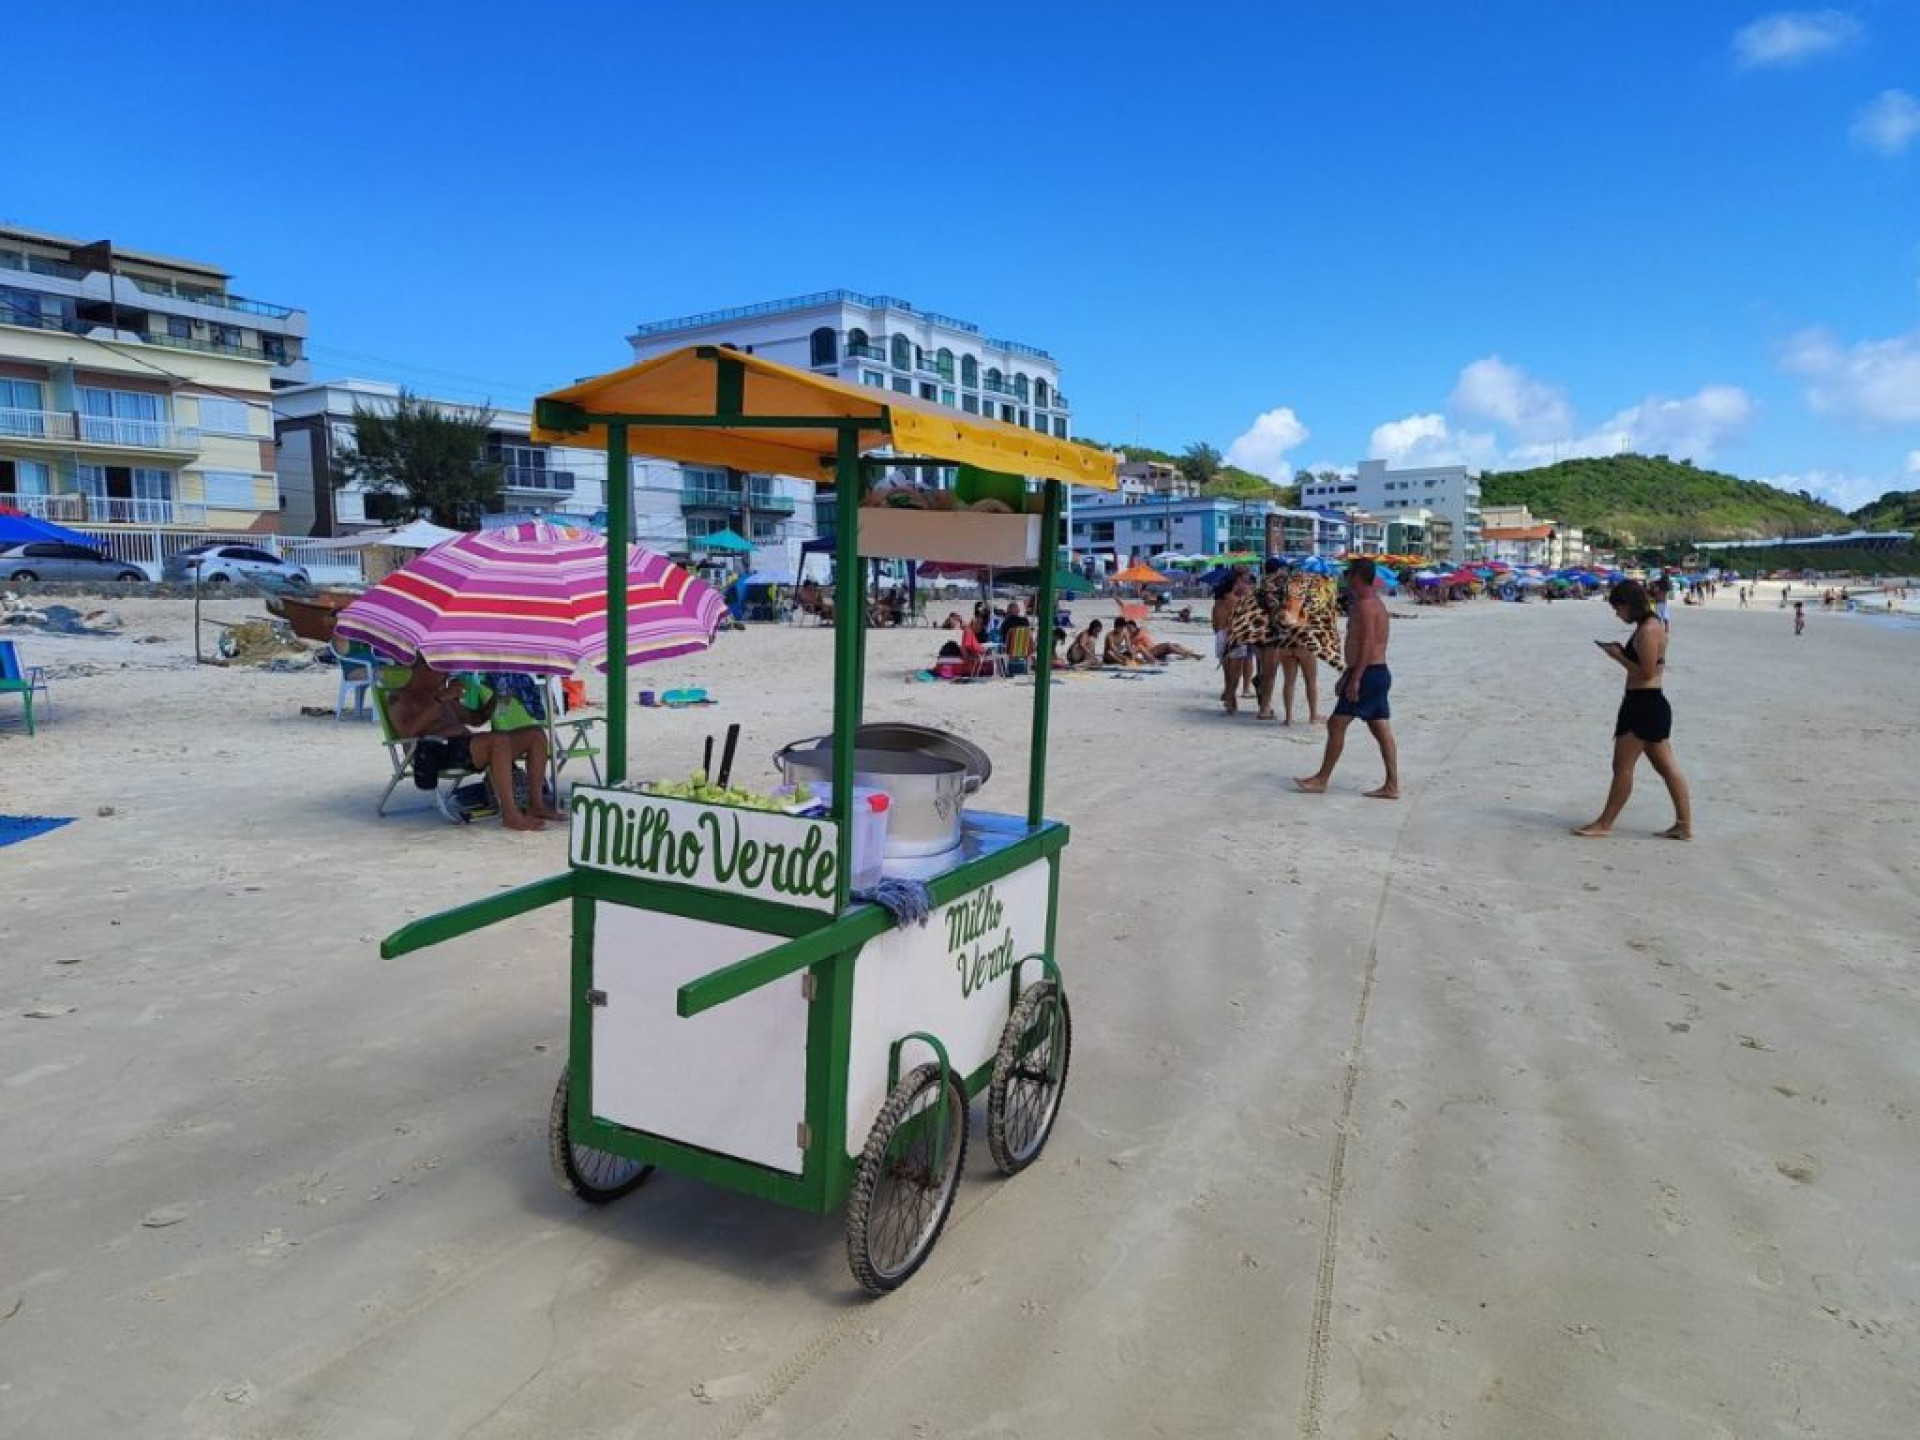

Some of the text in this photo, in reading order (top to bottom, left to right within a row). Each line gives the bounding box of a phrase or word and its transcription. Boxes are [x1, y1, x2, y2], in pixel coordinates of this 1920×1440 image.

[571, 794, 835, 899] Milho Verde
[945, 884, 1003, 953] Milho
[957, 926, 1014, 999] Verde
